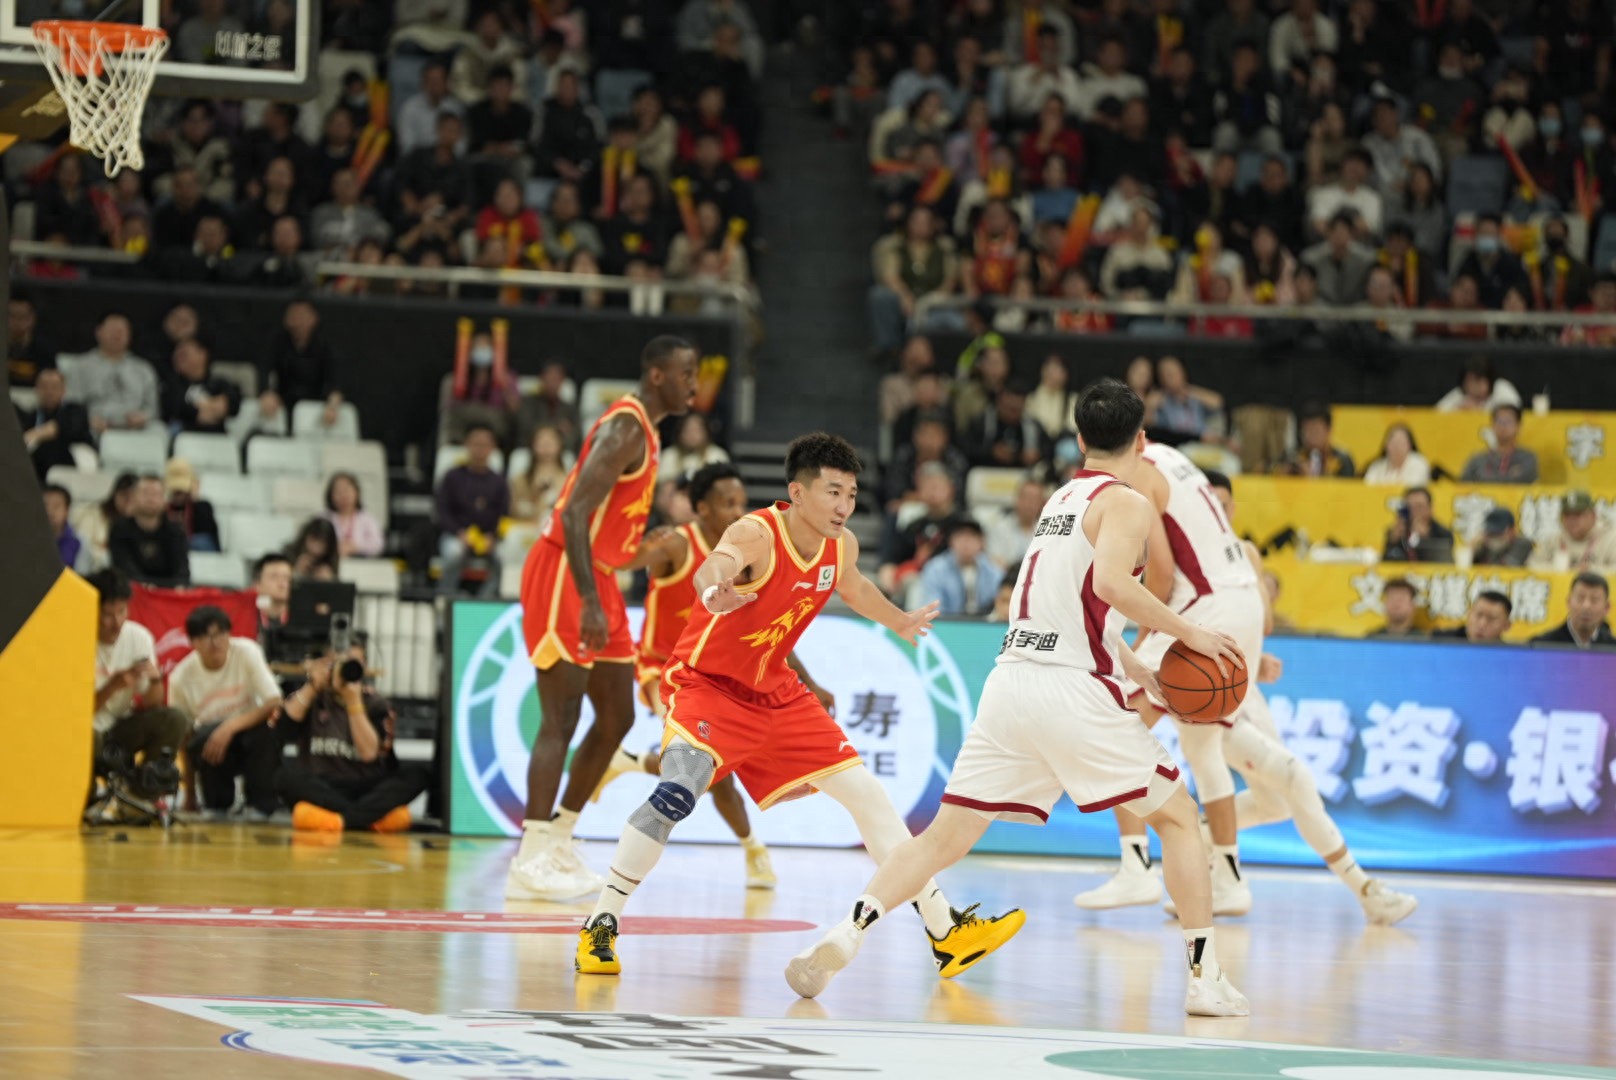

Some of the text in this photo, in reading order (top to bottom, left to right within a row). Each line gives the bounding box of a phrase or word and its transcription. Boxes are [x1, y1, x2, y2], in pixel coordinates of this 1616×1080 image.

[1016, 549, 1042, 621] 1
[846, 690, 900, 738] 寿
[1150, 695, 1616, 814] 投资·银
